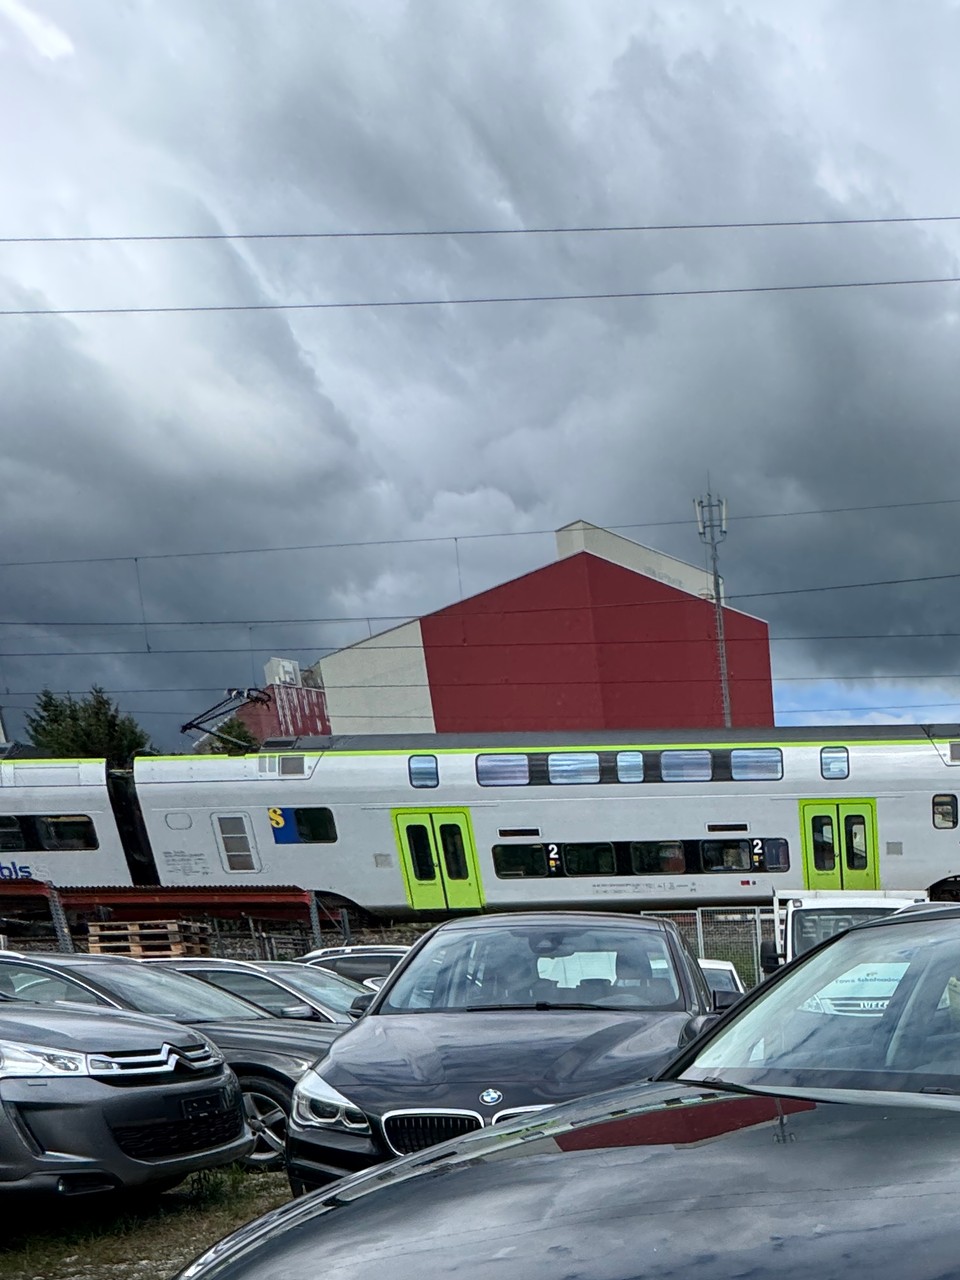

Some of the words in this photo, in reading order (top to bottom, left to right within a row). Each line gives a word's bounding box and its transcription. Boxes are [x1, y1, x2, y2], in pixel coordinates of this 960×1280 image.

[268, 807, 285, 828] S
[548, 843, 559, 859] 2
[753, 839, 763, 854] 2
